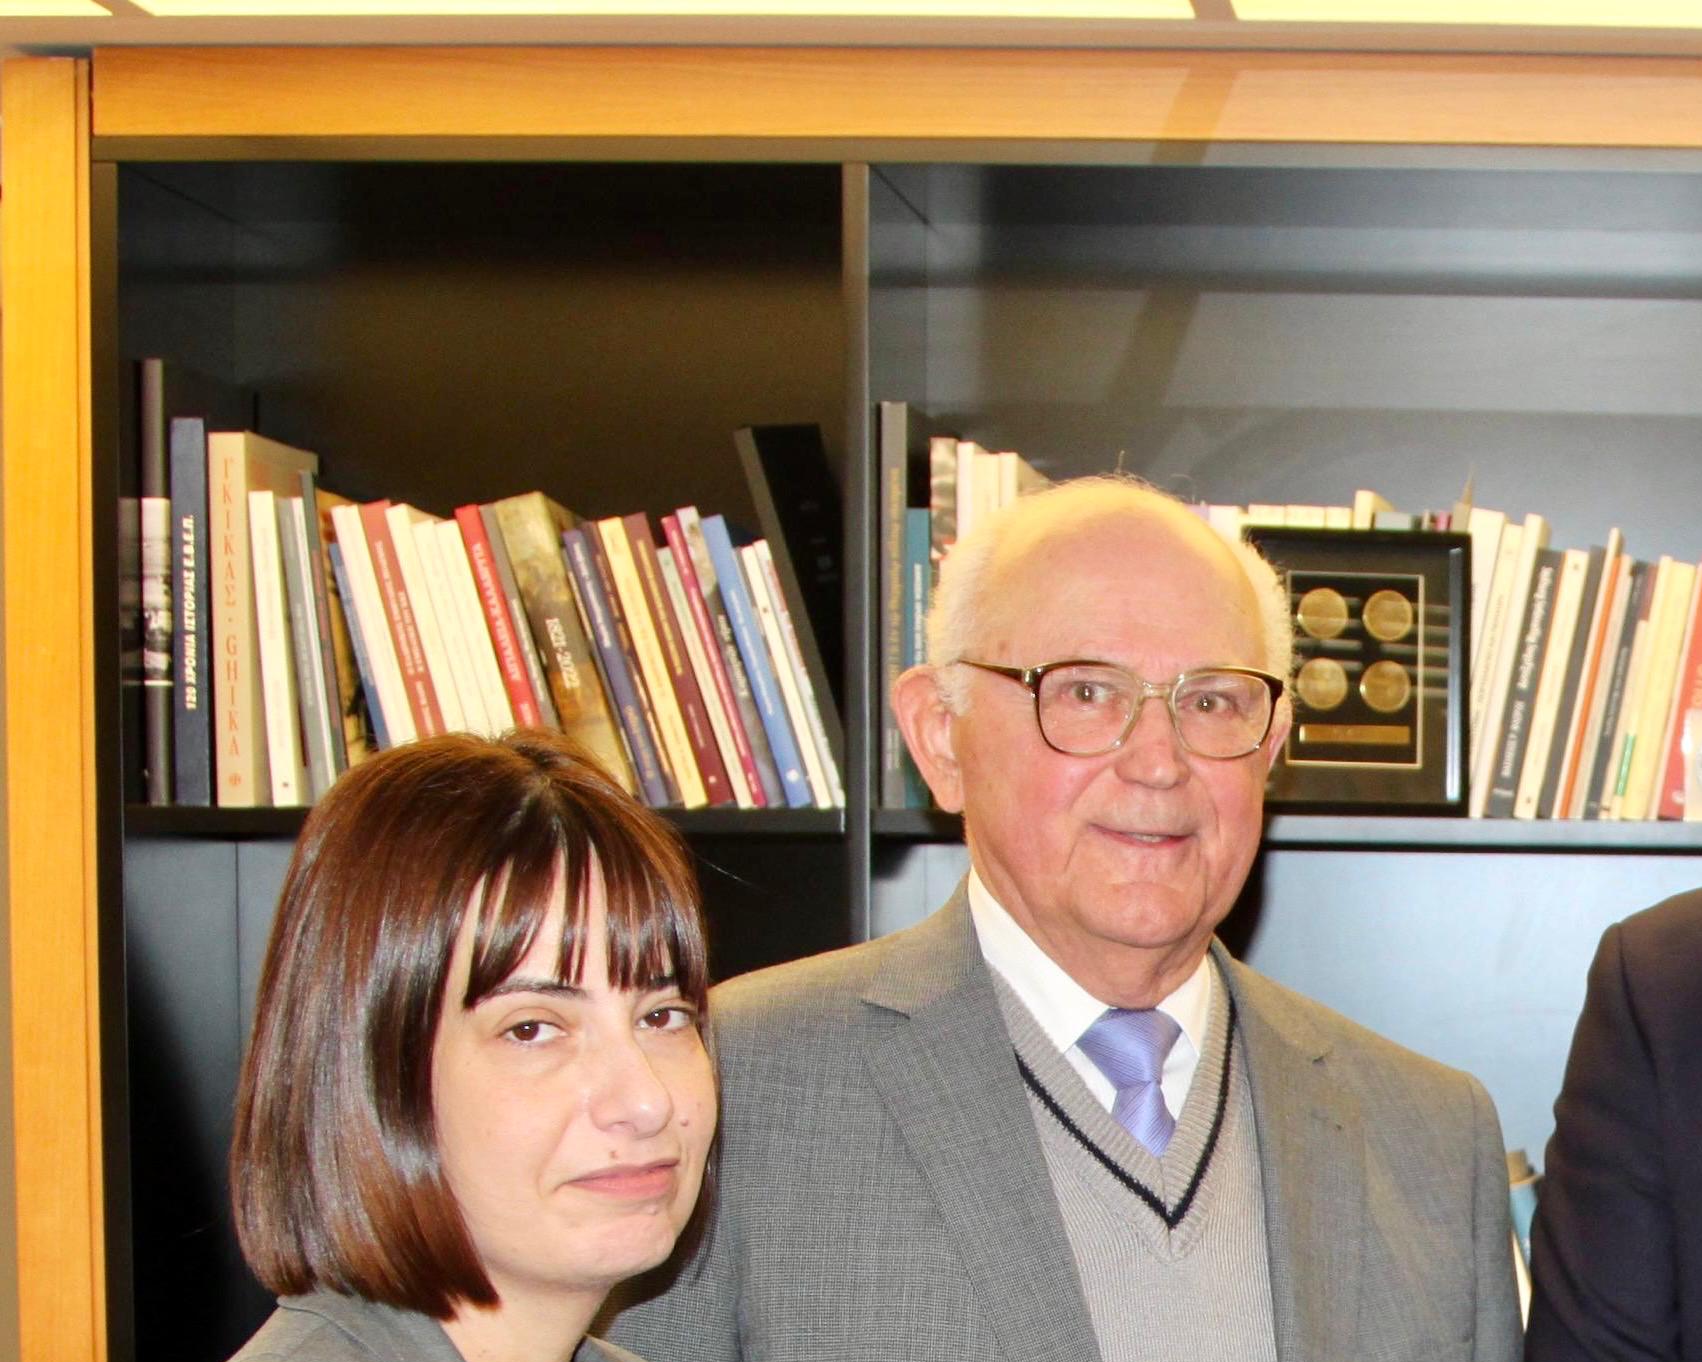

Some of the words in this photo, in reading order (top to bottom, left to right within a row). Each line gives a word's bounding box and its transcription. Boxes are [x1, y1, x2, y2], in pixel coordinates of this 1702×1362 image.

[183, 567, 197, 631] ΙΣΤΟΡΙΑΣ
[183, 633, 198, 685] ΧΡΟΝΙΑ
[225, 635, 241, 757] GHIKA
